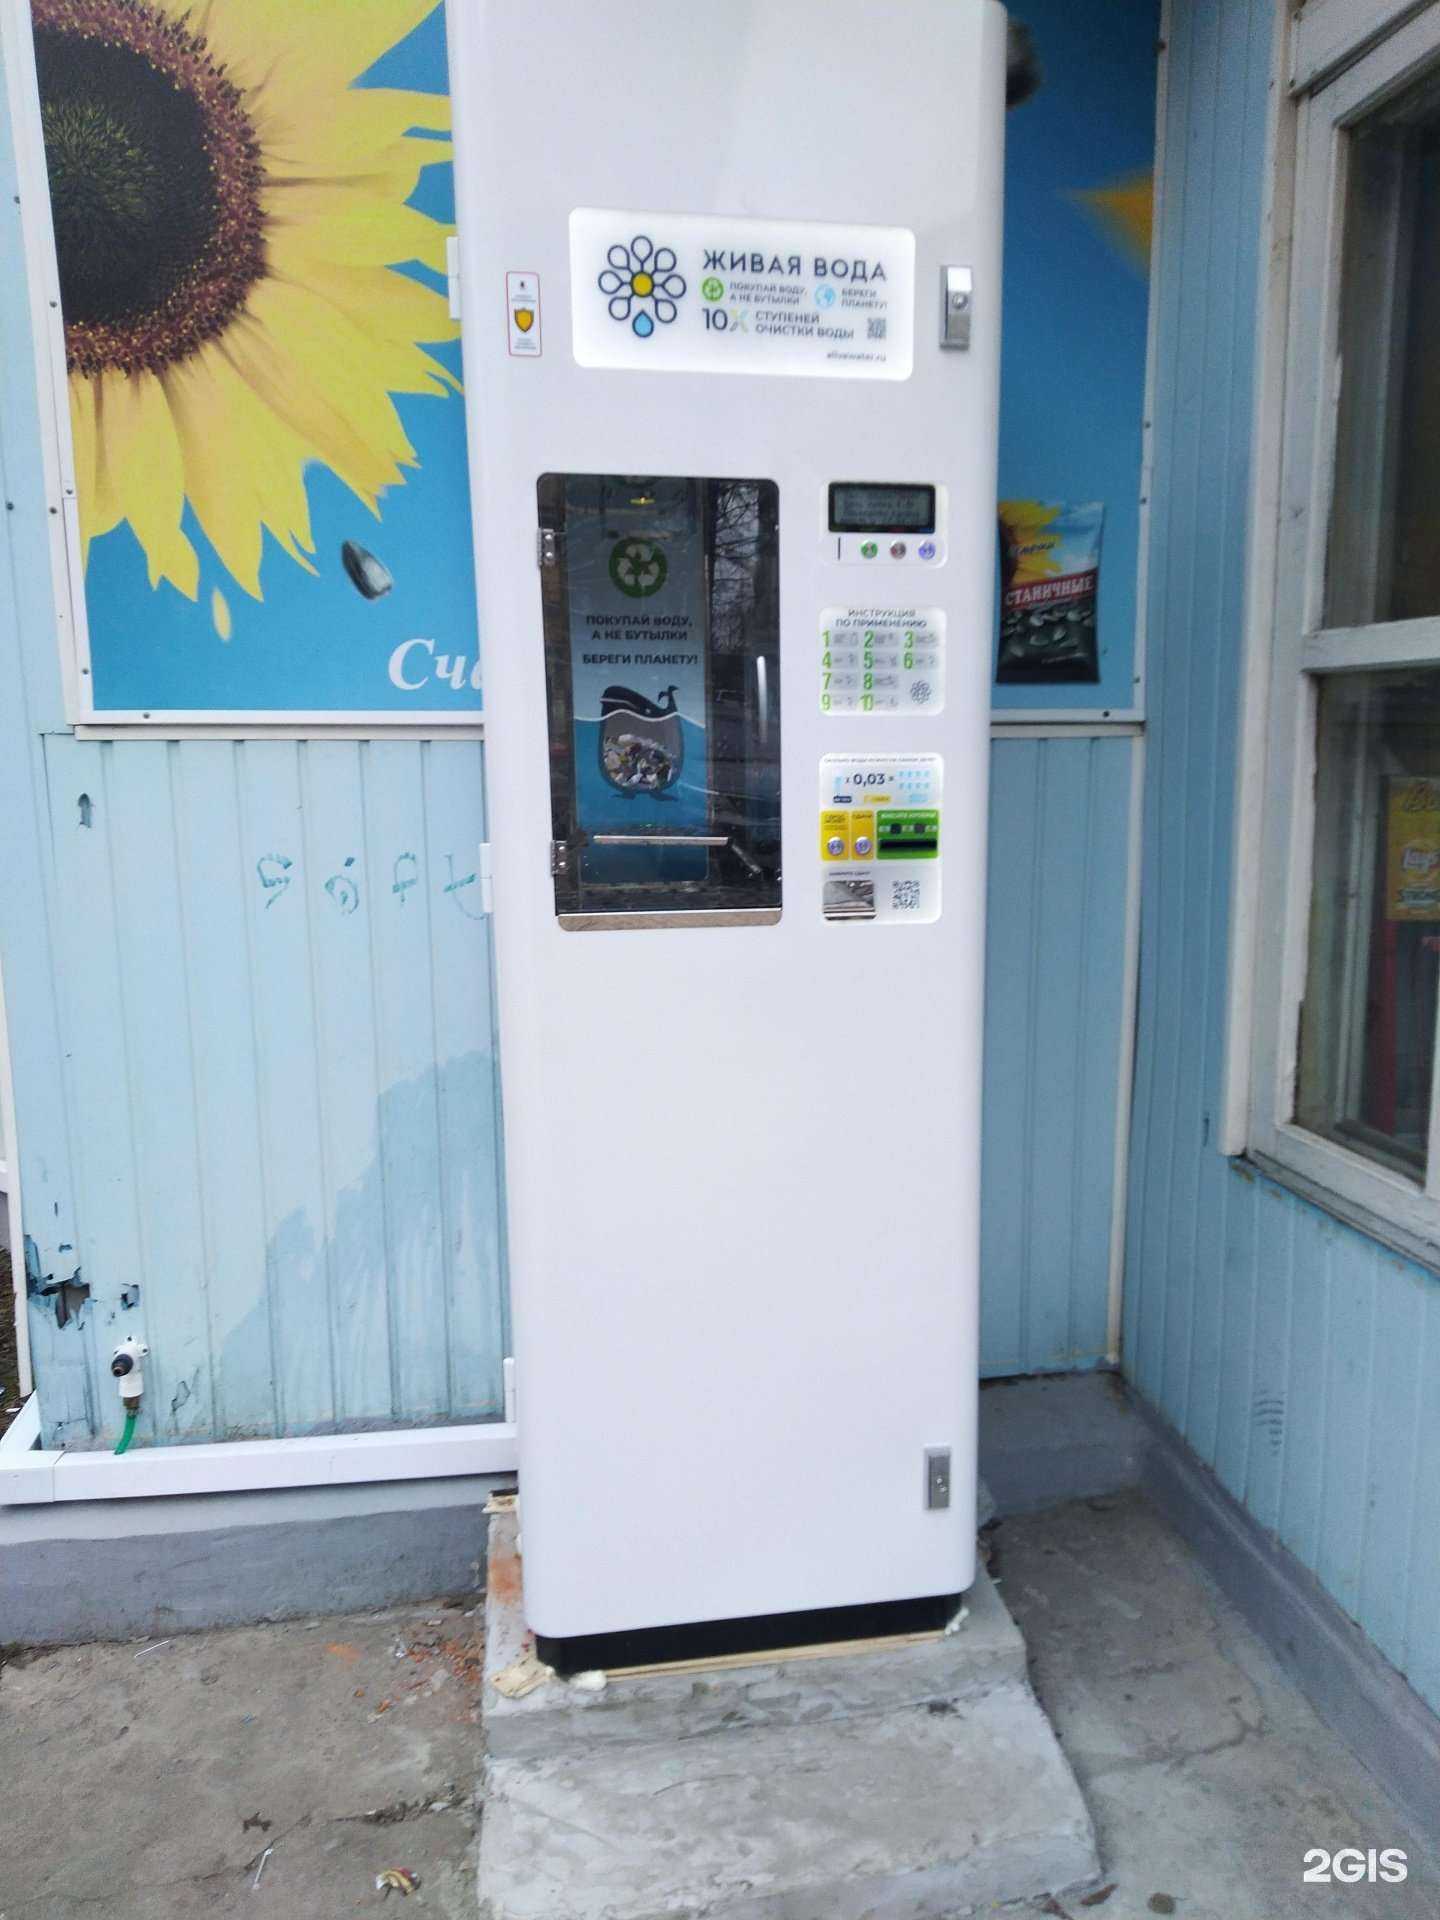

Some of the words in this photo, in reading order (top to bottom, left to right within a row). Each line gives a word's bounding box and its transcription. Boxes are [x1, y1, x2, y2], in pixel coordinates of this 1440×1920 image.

[703, 249, 801, 275] ЖИВАЯ
[814, 257, 887, 283] ВОДА
[755, 309, 820, 324] СТУПЕНЕЙ
[755, 325, 814, 338] ОЧИСТКИ
[817, 327, 855, 341] ВОДЫ
[1005, 574, 1094, 605] СТАНИЧНЫЕ
[586, 615, 650, 626] ПОКУПАЙ
[653, 616, 693, 627] ВОДУ,
[848, 608, 916, 617] ИНСТРУКЦИЯ
[835, 618, 851, 627] ПО
[853, 618, 927, 628] ПРИМЕНЕНИЮ
[592, 630, 600, 640] А
[605, 630, 621, 640] НЕ
[625, 630, 688, 640] БУТЫЛКИ
[822, 630, 831, 648] 1
[864, 630, 873, 648] 2
[904, 630, 913, 648] 3
[582, 654, 631, 664] БЕРЕГИ
[634, 654, 698, 664] ПЛАНЕТУ!
[822, 651, 831, 669] 4
[864, 651, 873, 669] 5
[904, 652, 913, 669] 6
[822, 672, 832, 690] 7
[864, 672, 873, 690] 8
[822, 694, 831, 711] 9
[860, 694, 873, 711] 10
[853, 773, 885, 787] 0,03
